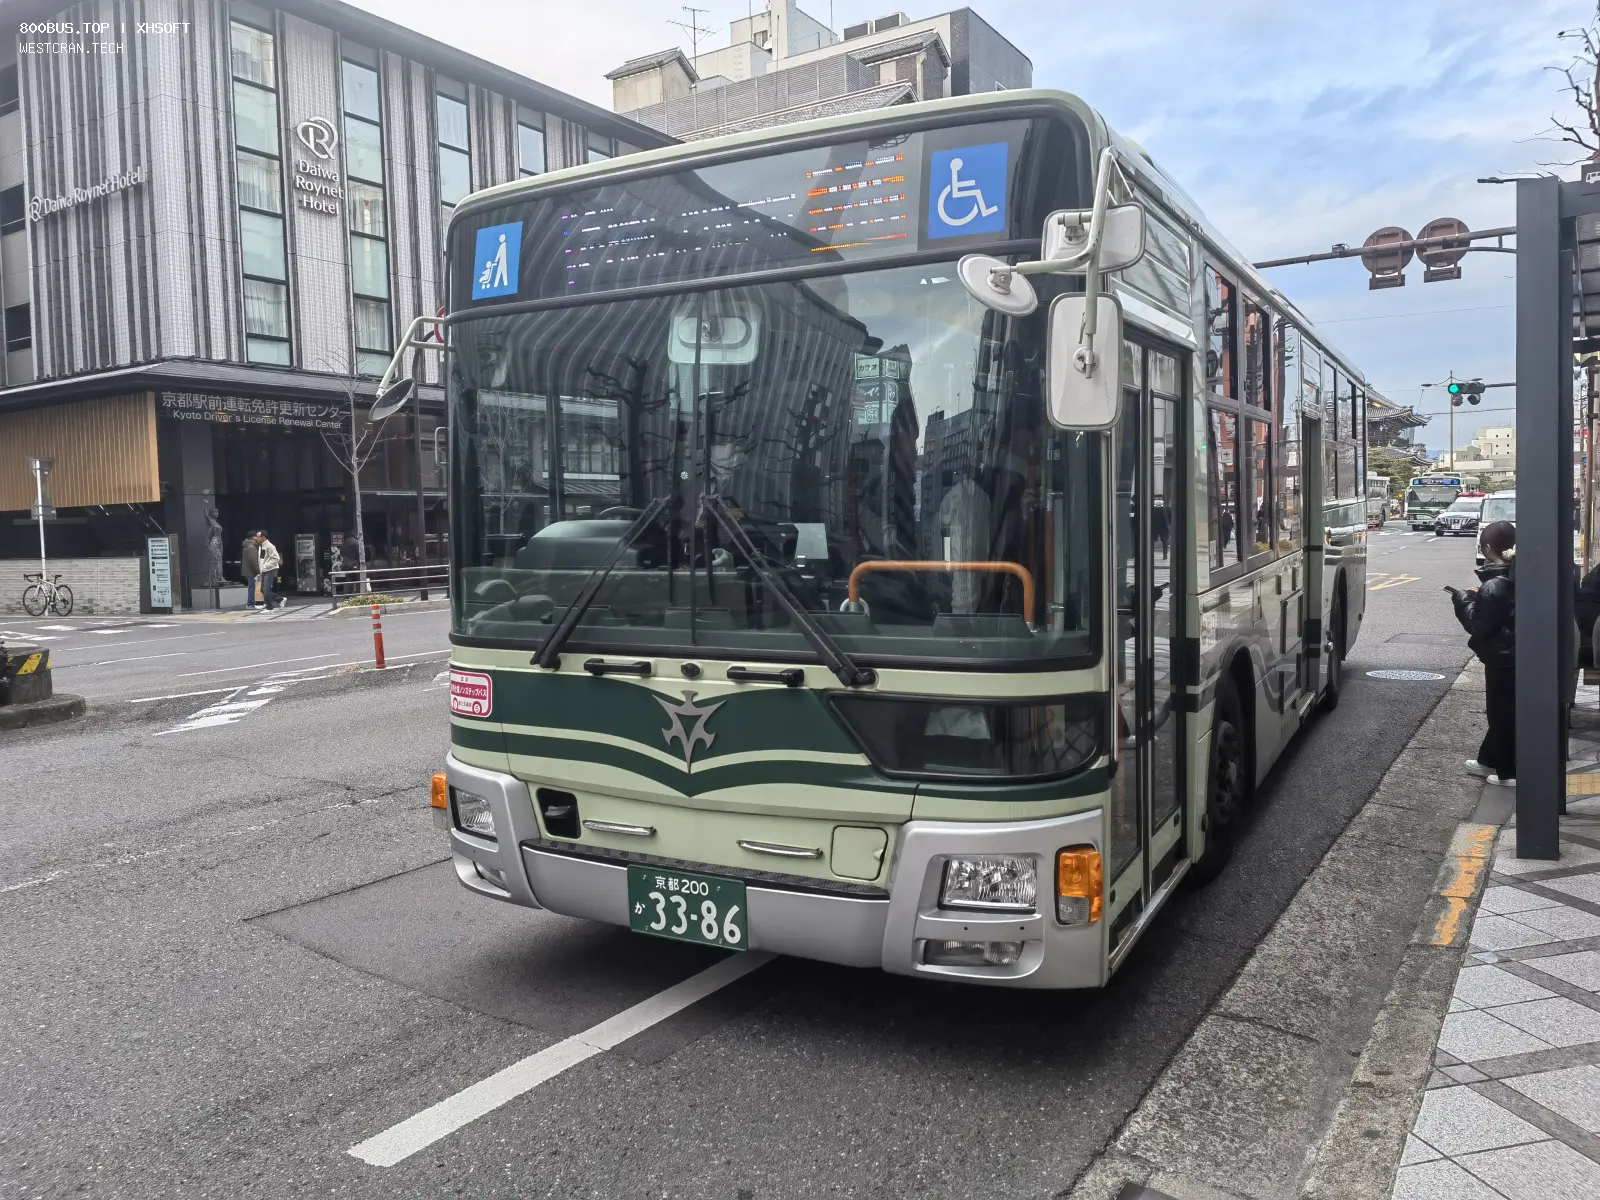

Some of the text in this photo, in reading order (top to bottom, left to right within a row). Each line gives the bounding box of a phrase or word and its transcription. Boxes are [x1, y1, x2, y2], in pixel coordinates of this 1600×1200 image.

[299, 159, 339, 182] Daiwa
[44, 194, 73, 214] Daiwa
[74, 177, 110, 204] Roynet
[110, 165, 142, 192] Hotel
[296, 175, 344, 199] Roynet
[303, 194, 339, 215] Hotel
[161, 391, 351, 418] 京都駅前運転免許更新センター
[173, 409, 202, 420] Kyoto
[243, 413, 277, 424] License
[279, 416, 313, 427] Renewal
[315, 419, 342, 429] Center
[634, 892, 741, 944] か 33-86
